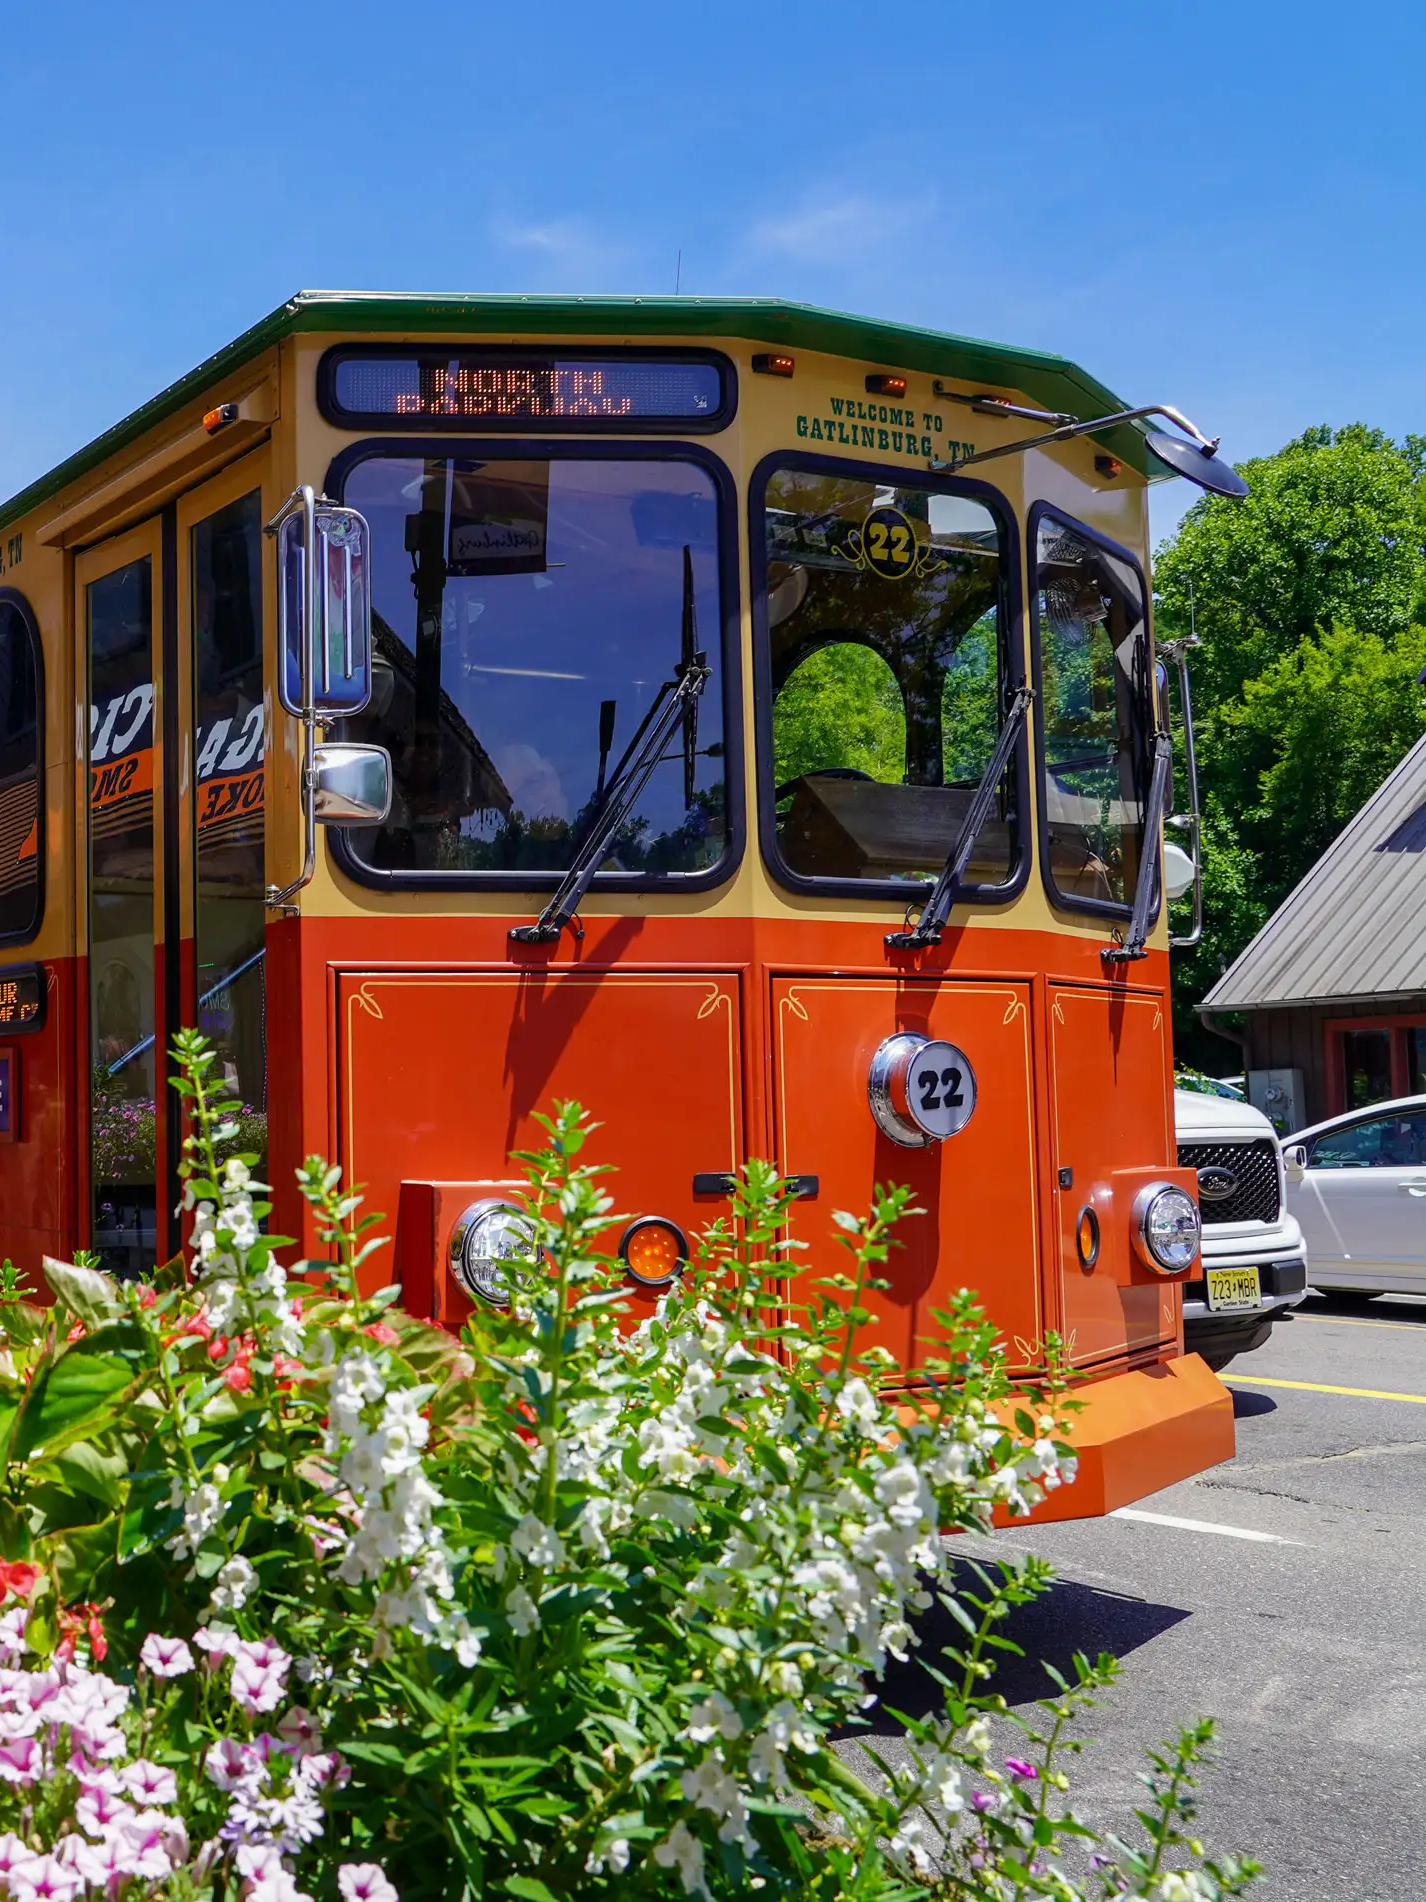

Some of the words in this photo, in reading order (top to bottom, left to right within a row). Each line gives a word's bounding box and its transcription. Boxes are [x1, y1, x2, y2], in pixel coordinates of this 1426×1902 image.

[434, 368, 603, 395] NORTH
[830, 397, 915, 428] WELCOME
[922, 413, 943, 433] TO
[796, 415, 939, 461] GATLINBURG,
[948, 440, 975, 463] TN
[8, 533, 23, 568] TN
[868, 522, 911, 564] 22
[917, 1067, 965, 1111] 22
